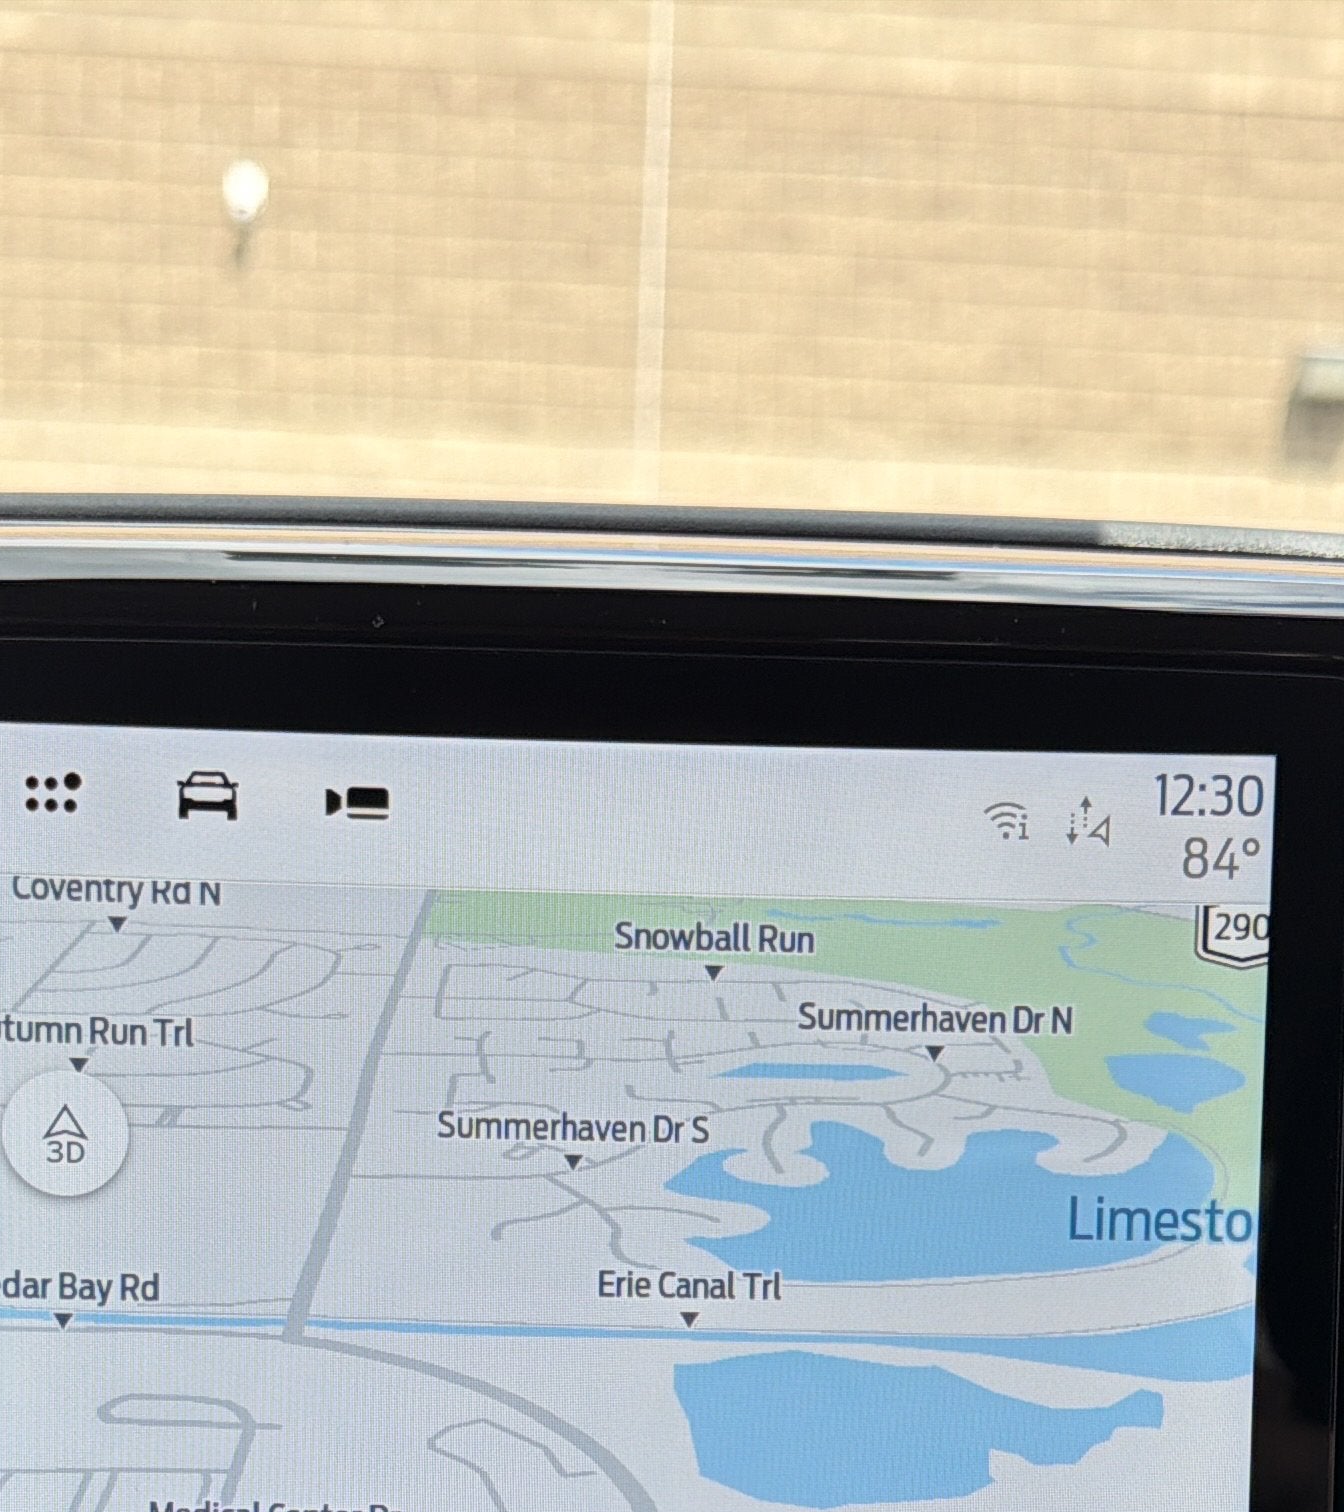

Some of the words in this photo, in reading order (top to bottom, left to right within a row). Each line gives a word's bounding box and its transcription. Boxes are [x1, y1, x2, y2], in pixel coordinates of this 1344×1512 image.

[1155, 772, 1265, 818] 12:30
[12, 875, 144, 909] Coventry
[151, 880, 191, 906] Rd
[199, 880, 222, 907] N
[614, 921, 751, 953] Snowball
[759, 924, 815, 954] Run
[1214, 912, 1270, 941] 290
[89, 1016, 147, 1046] Run
[153, 1018, 194, 1048] Trl
[797, 1001, 1007, 1033] Summerhaven
[1013, 1005, 1046, 1035] Dr
[1051, 1006, 1073, 1035] N
[437, 1110, 646, 1143] Summerhaven
[653, 1114, 684, 1143] Dr
[691, 1115, 710, 1144] S
[45, 1140, 86, 1164] 3D
[1068, 1195, 1253, 1244] Limesto
[58, 1271, 113, 1307] Bay
[120, 1272, 160, 1302] Rd
[598, 1269, 651, 1299] Erie
[658, 1269, 735, 1301] Canal
[742, 1271, 782, 1302] Trl
